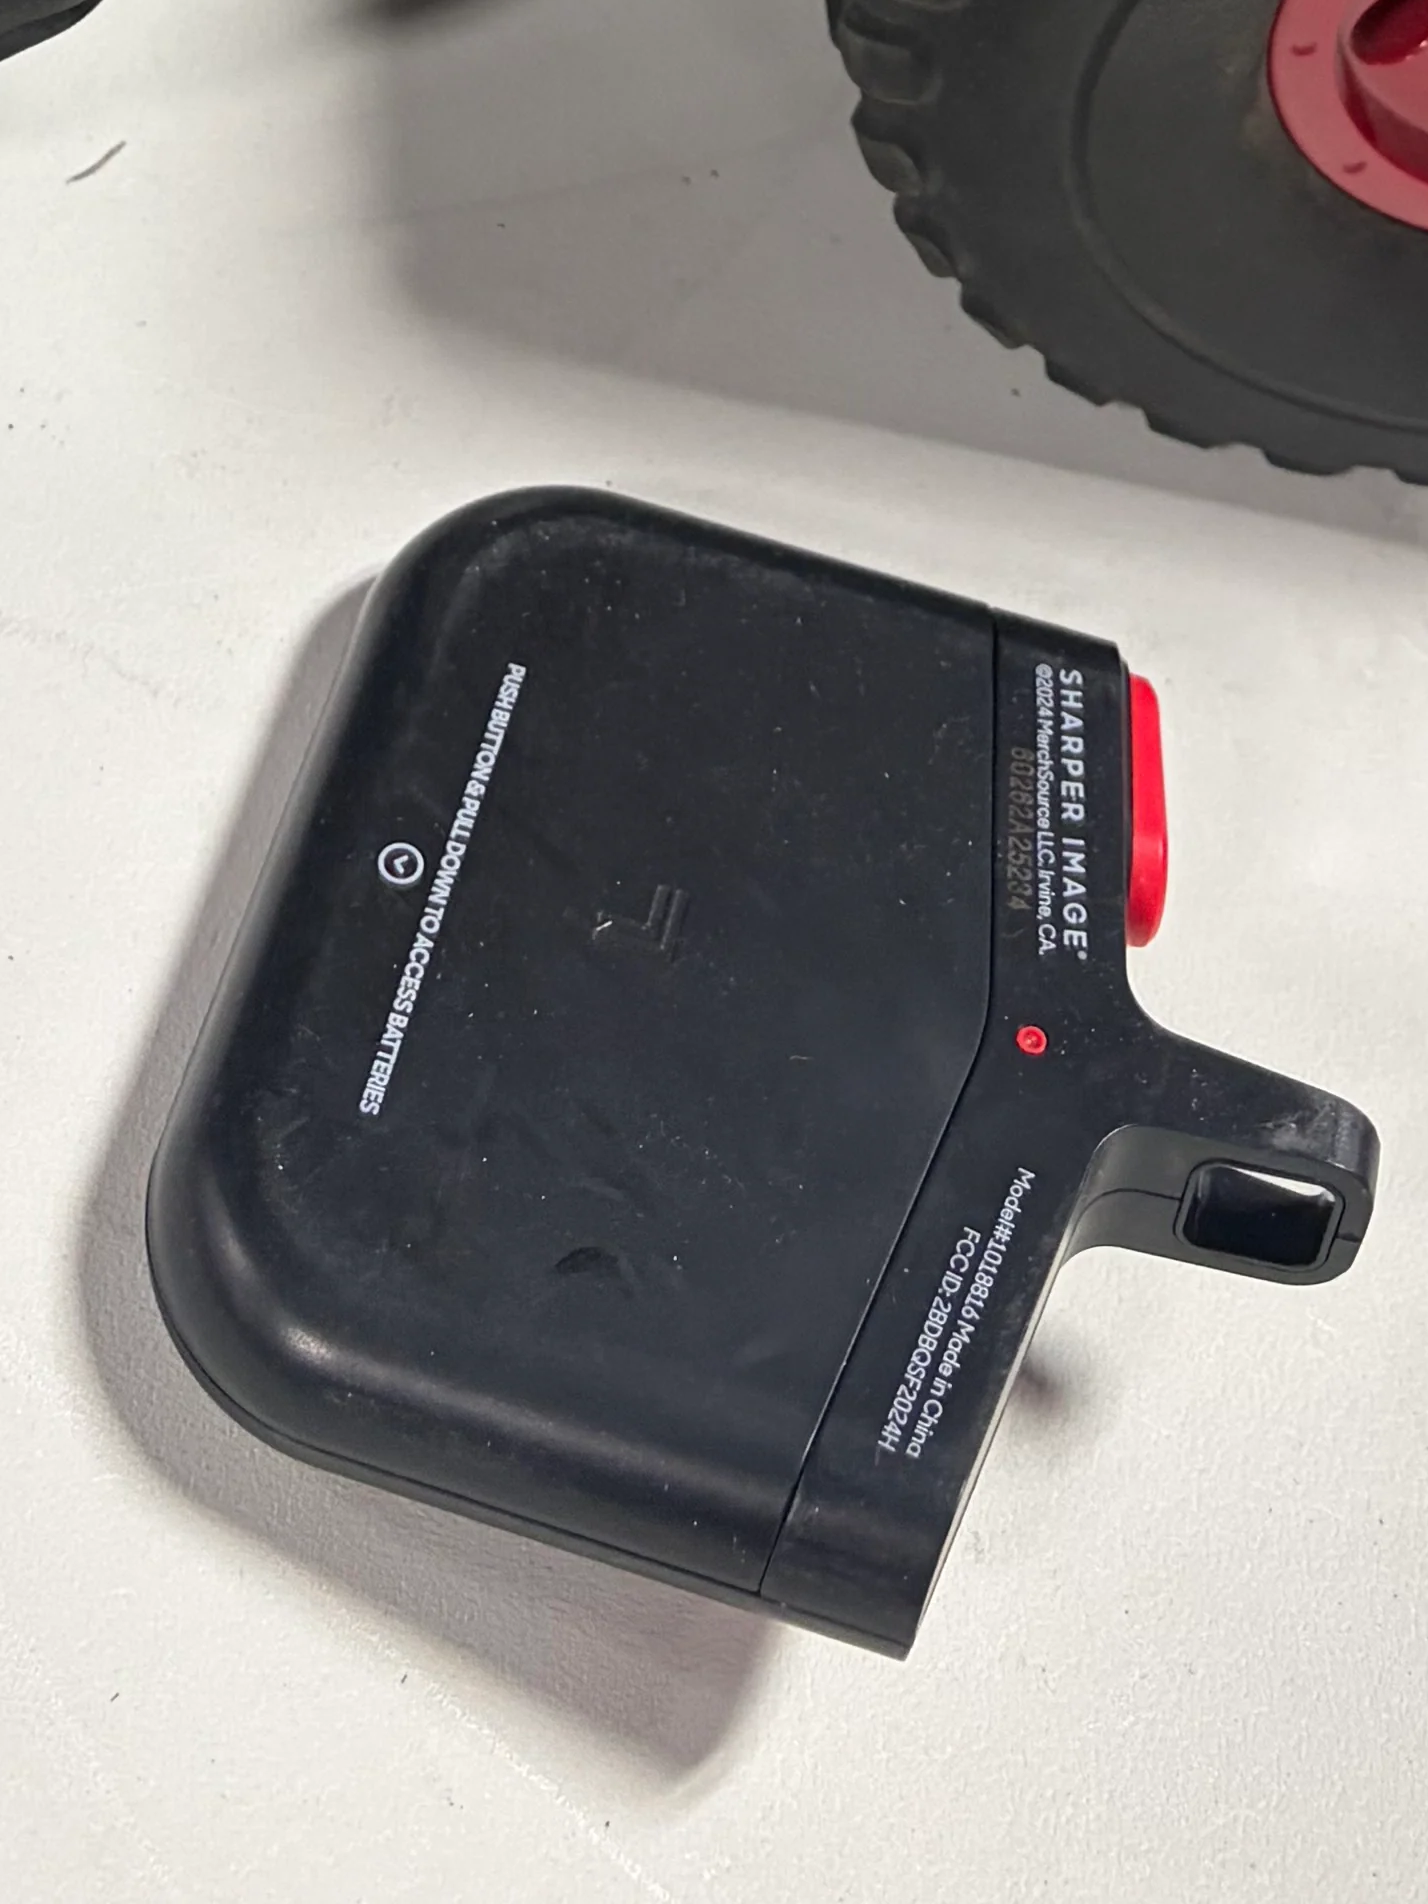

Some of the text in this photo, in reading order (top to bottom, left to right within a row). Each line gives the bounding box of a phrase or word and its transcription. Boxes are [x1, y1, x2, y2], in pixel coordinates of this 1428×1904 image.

[1036, 719, 1054, 829] MerchSource
[1059, 668, 1085, 821] SHARPER
[359, 662, 527, 1116] PUSH BUTTON & PULL DOWN TO ACCESS BATTERIES
[1036, 869, 1055, 920] Irvine,
[1038, 923, 1057, 955] CA.
[878, 1226, 982, 1453] FCC ID: 2BDBQSF2024H
[905, 1167, 1037, 1459] Model#1018816 Made in China
